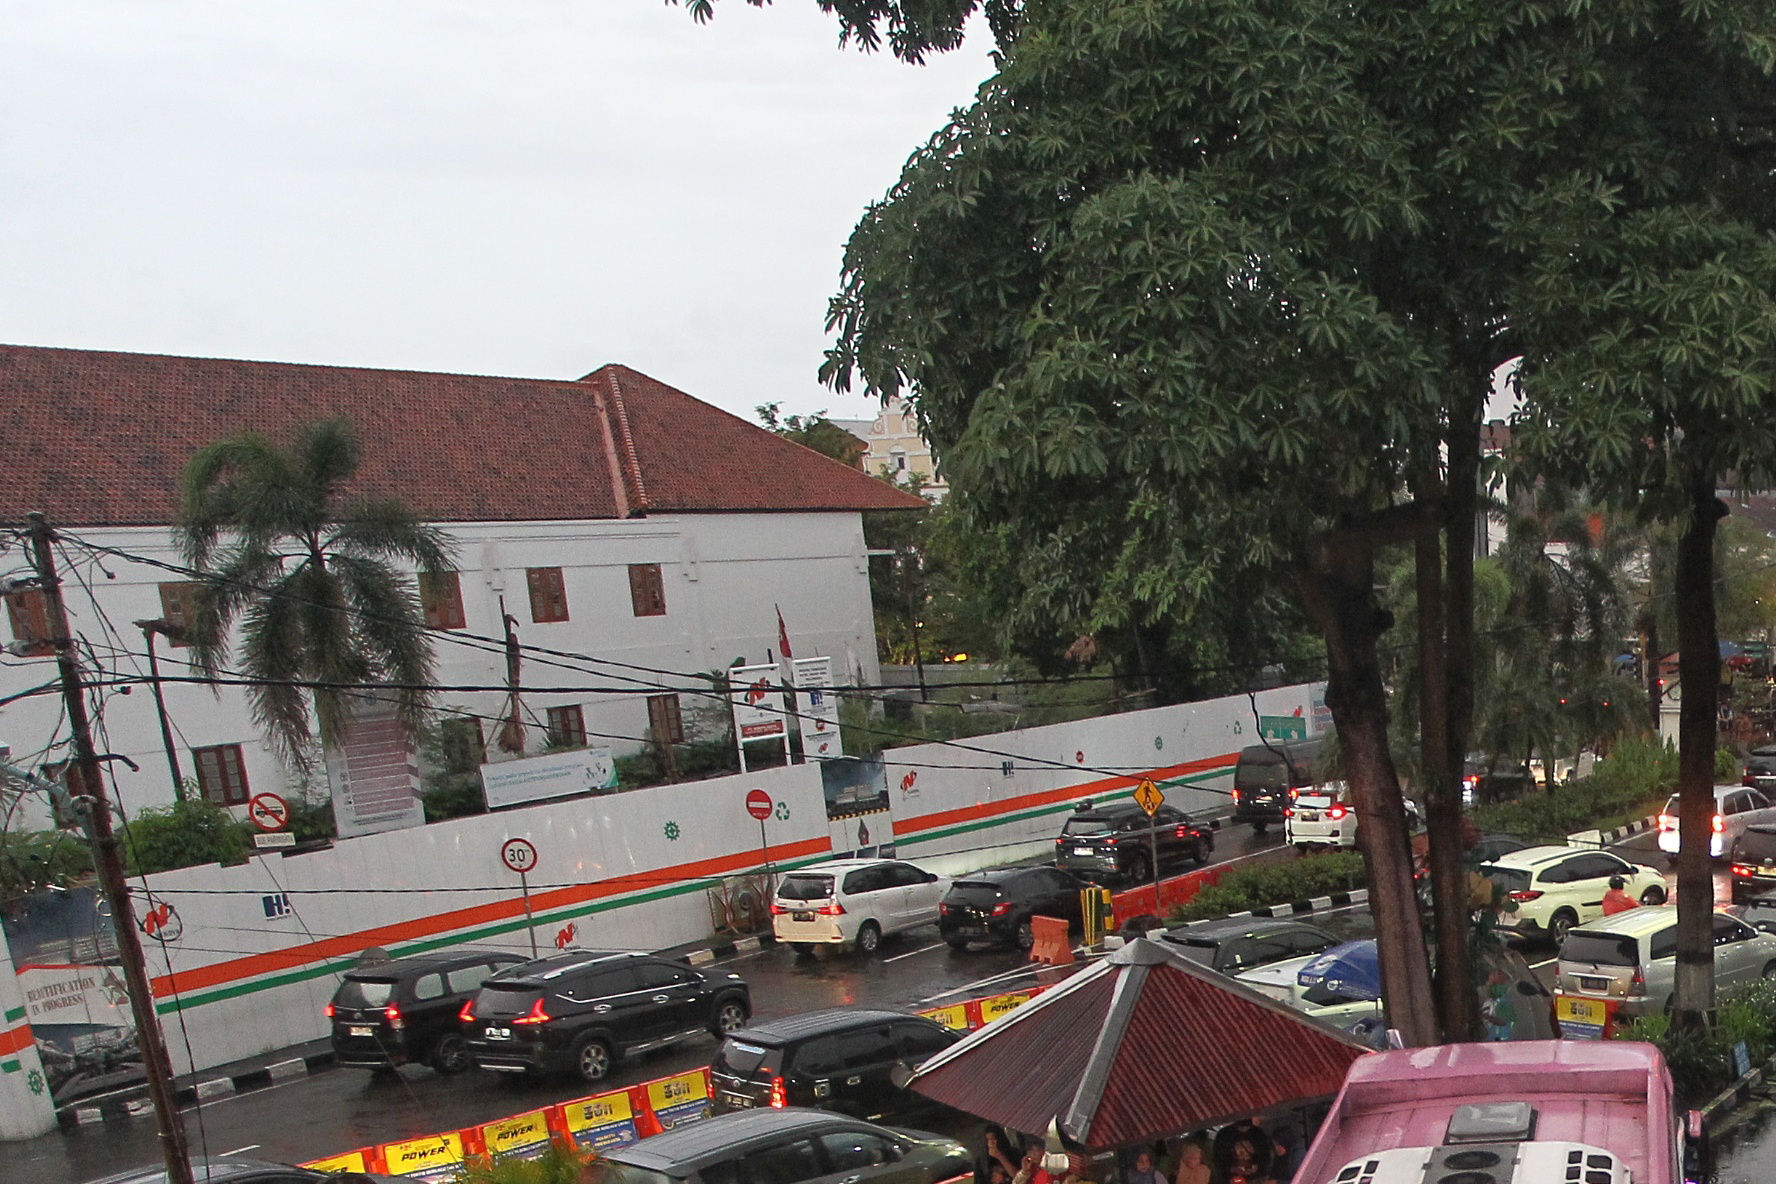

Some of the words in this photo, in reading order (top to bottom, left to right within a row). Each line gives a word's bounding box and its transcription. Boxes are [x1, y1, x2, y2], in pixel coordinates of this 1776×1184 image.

[508, 848, 525, 862] 30
[496, 1125, 534, 1141] POWER
[401, 1146, 446, 1162] POWER
